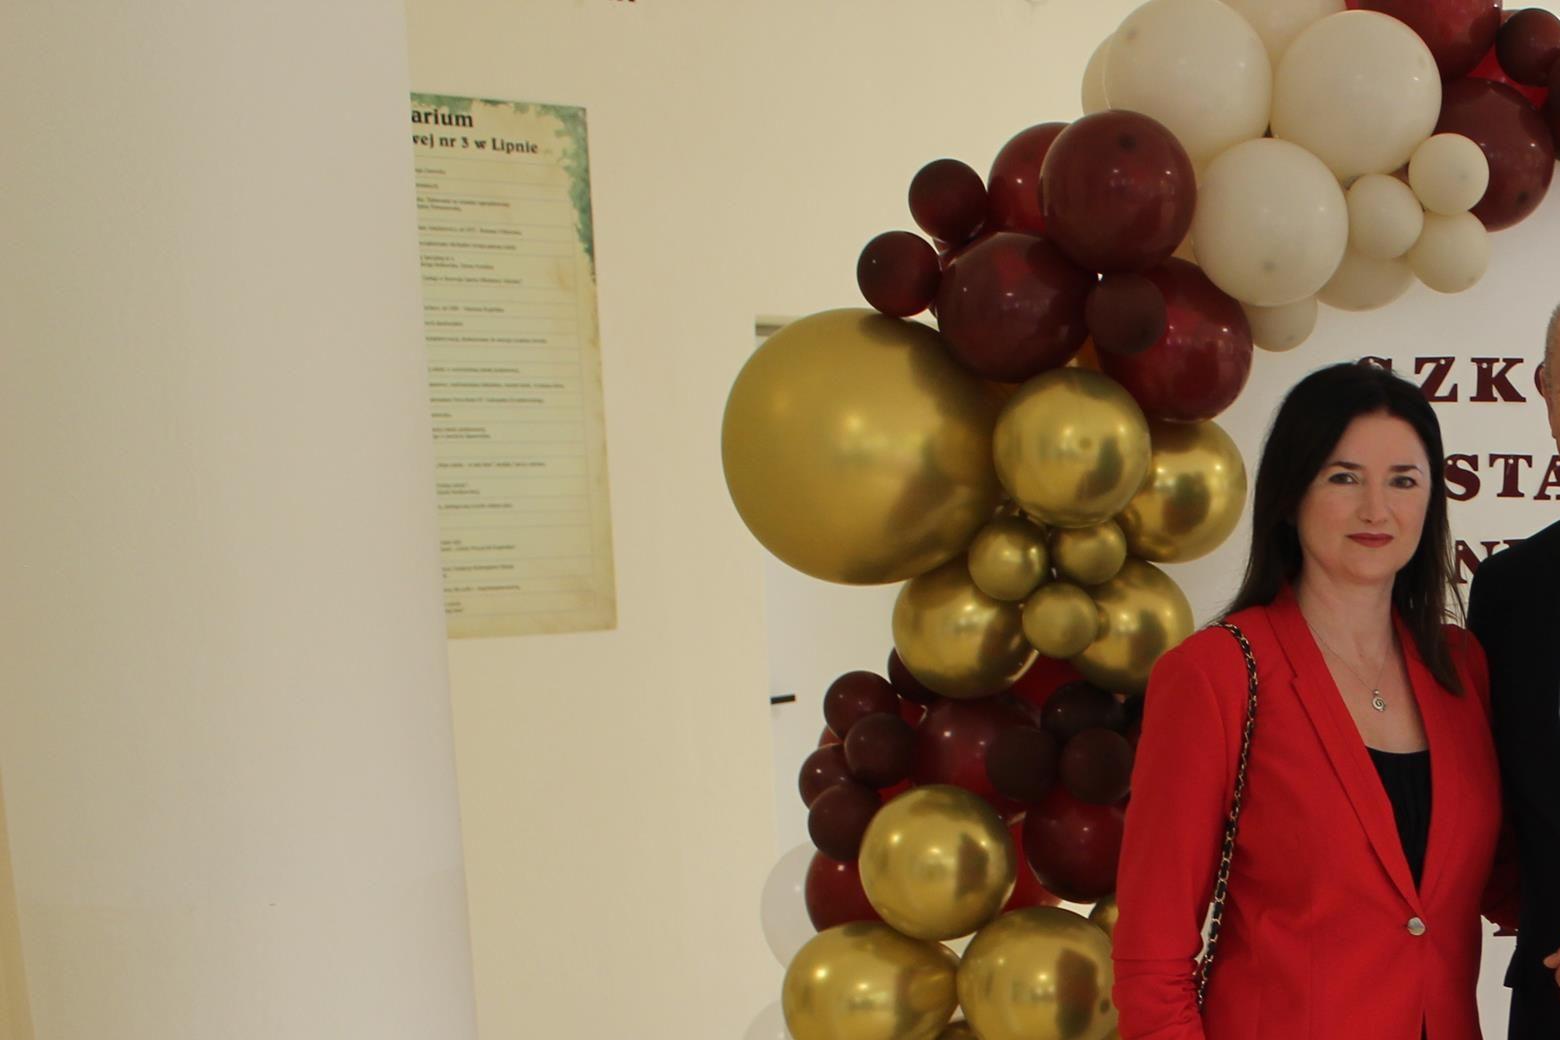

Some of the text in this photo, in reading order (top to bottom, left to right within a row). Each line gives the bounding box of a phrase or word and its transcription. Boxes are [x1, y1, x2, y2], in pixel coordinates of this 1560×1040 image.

[411, 109, 473, 128] arium
[439, 136, 456, 148] nr
[474, 139, 487, 149] w
[491, 137, 538, 154] Lipnie
[1358, 356, 1546, 403] ZK
